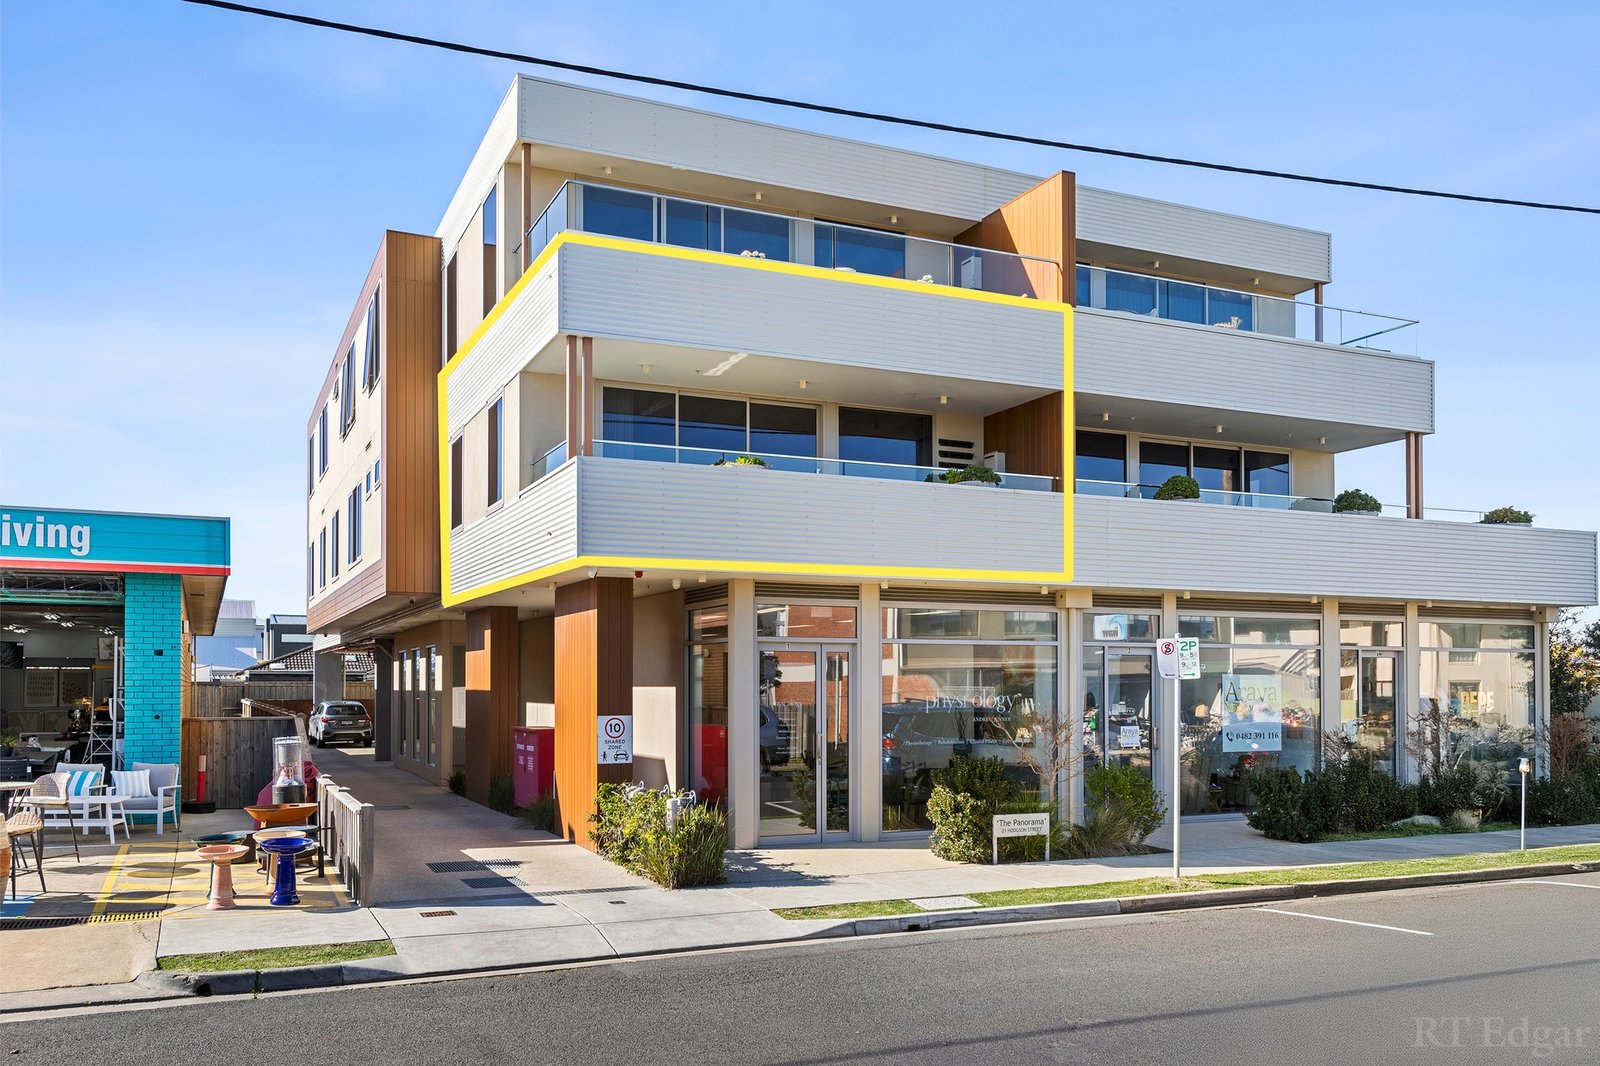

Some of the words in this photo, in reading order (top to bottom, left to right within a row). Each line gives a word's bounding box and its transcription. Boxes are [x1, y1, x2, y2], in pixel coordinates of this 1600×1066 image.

[1, 514, 91, 557] iving
[1179, 641, 1197, 651] 2P
[609, 723, 621, 733] 10
[1236, 732, 1252, 740] 0482
[1253, 732, 1265, 740] 391
